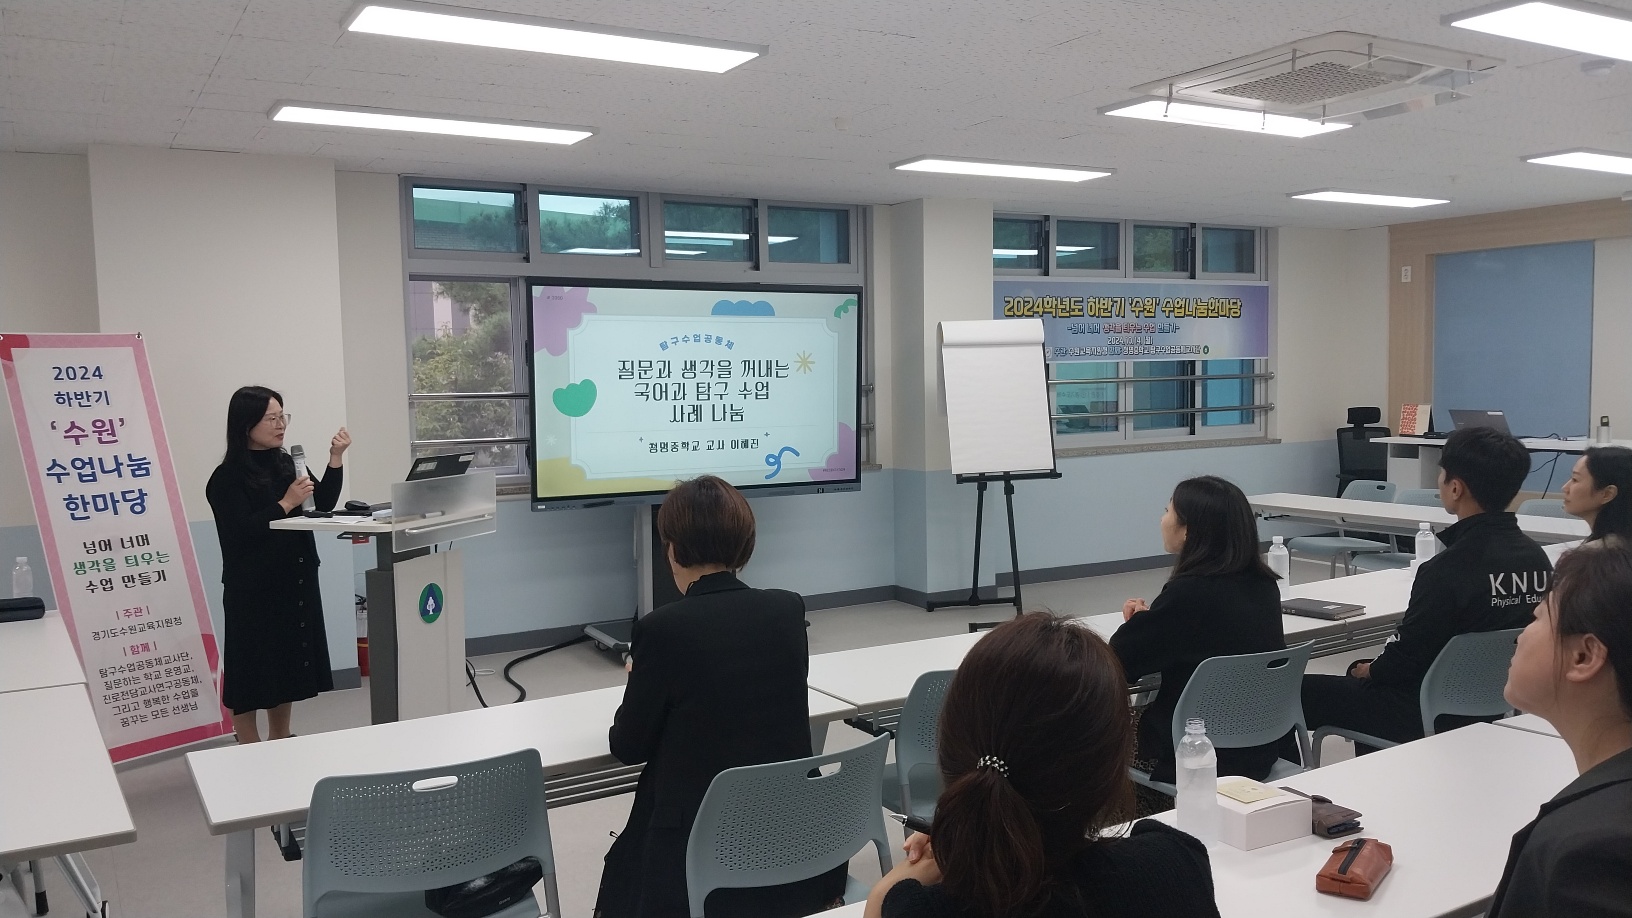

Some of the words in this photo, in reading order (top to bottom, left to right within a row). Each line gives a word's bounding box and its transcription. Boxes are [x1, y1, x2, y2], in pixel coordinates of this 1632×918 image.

[1004, 295, 1084, 318] 2024학년도
[1087, 296, 1125, 318] 하반기
[1161, 296, 1242, 318] 수업나눔한마당
[1102, 323, 1122, 334] 생각을
[1143, 323, 1156, 333] 수업
[659, 333, 735, 351] 탐구수업공동체
[52, 366, 103, 381] 2024
[618, 359, 672, 380] 질문과
[681, 359, 732, 379] 생각을
[741, 359, 790, 379] 꺼내는
[54, 391, 110, 408] 하반기
[634, 381, 687, 401] 국어과
[696, 381, 729, 400] 탐구
[738, 381, 770, 400] 수업
[669, 404, 703, 423] 사례
[711, 403, 744, 422] 나눔
[706, 440, 725, 450] 교사
[46, 453, 152, 484] 수업나눔
[62, 488, 148, 521] 한마당
[120, 533, 151, 550] 너머
[73, 557, 117, 576] 생각을
[85, 578, 114, 594] 수업
[121, 569, 167, 589] 만들기
[1491, 595, 1521, 608] Physical
[123, 606, 143, 619] 주관
[91, 616, 183, 641] 경기도수원교육지원청
[129, 642, 151, 656] 함께
[103, 675, 142, 691] 질문하는
[143, 670, 162, 682] 학교
[112, 701, 140, 716] 그리고
[143, 695, 170, 709] 행복한
[172, 688, 199, 702] 수업을
[120, 714, 149, 728] 꿈꾸는
[150, 707, 170, 720] 모든
[172, 701, 199, 716] 선생님
